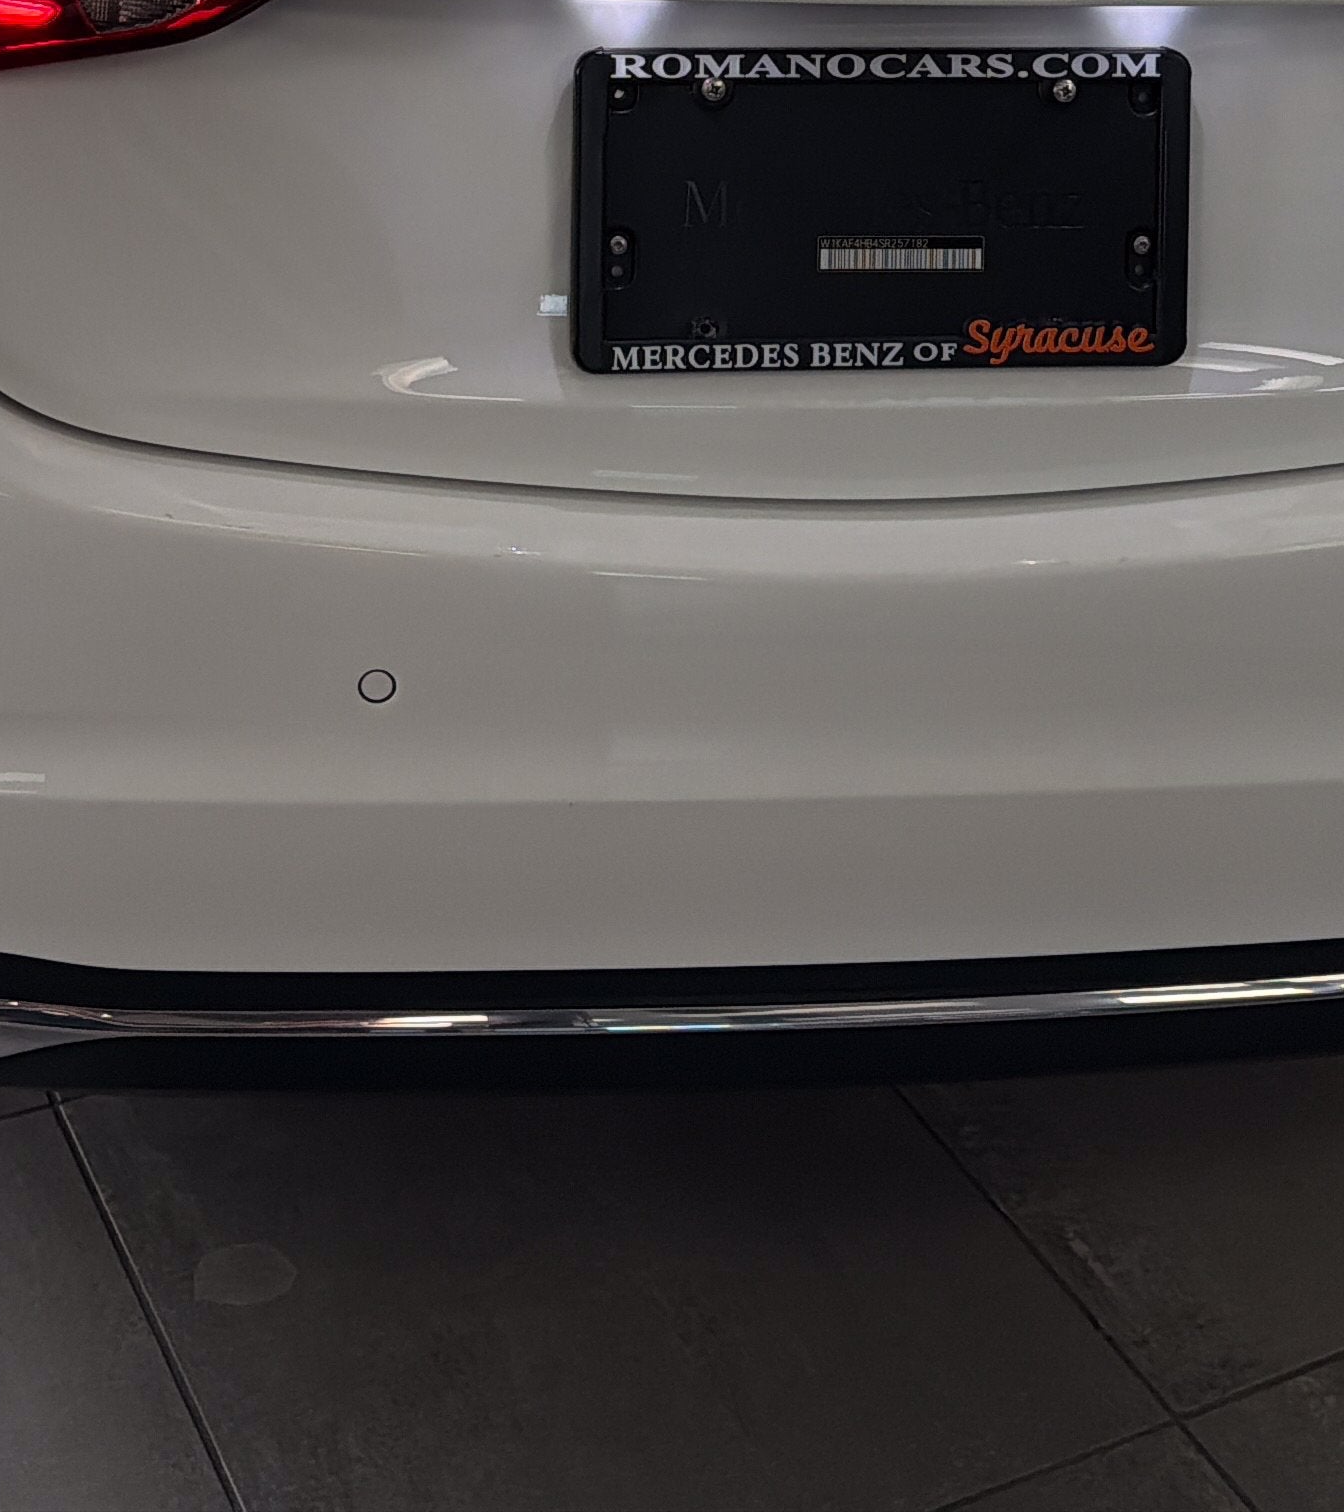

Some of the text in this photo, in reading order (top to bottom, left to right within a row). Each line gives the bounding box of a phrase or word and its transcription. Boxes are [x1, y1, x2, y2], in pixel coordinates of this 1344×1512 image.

[610, 53, 1162, 79] ROMANOCARS.COM
[611, 318, 1156, 371] MERCEDES BENZ OF Syracuse
